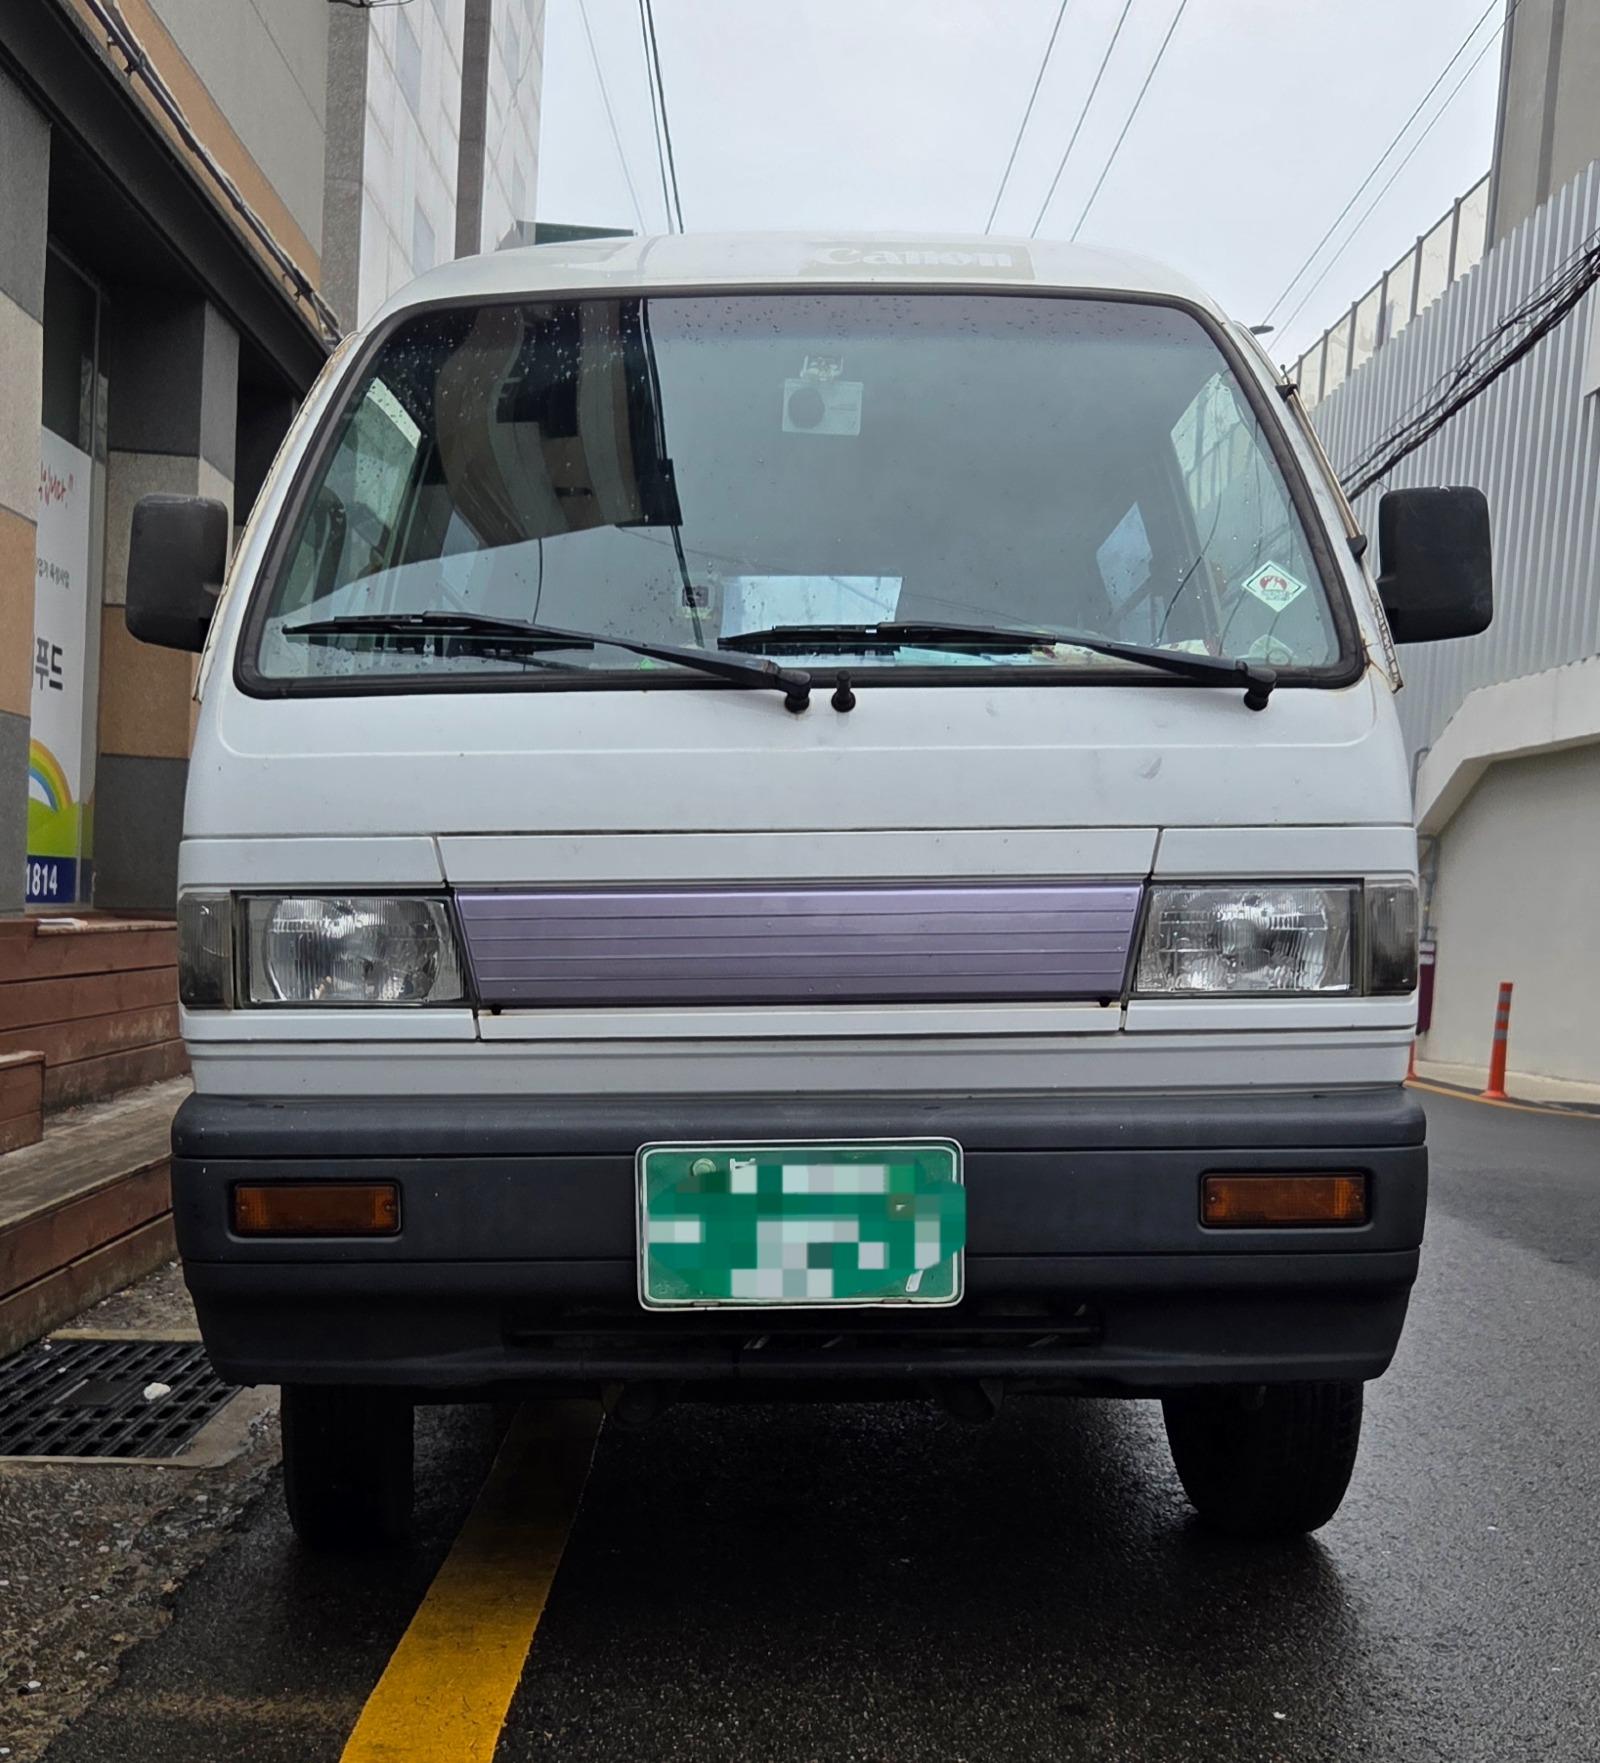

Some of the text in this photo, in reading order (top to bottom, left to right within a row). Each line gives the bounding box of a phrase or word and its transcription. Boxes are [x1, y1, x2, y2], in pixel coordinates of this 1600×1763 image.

[814, 246, 1014, 268] Canon
[35, 637, 63, 691] 푸드
[26, 862, 58, 896] 1814
